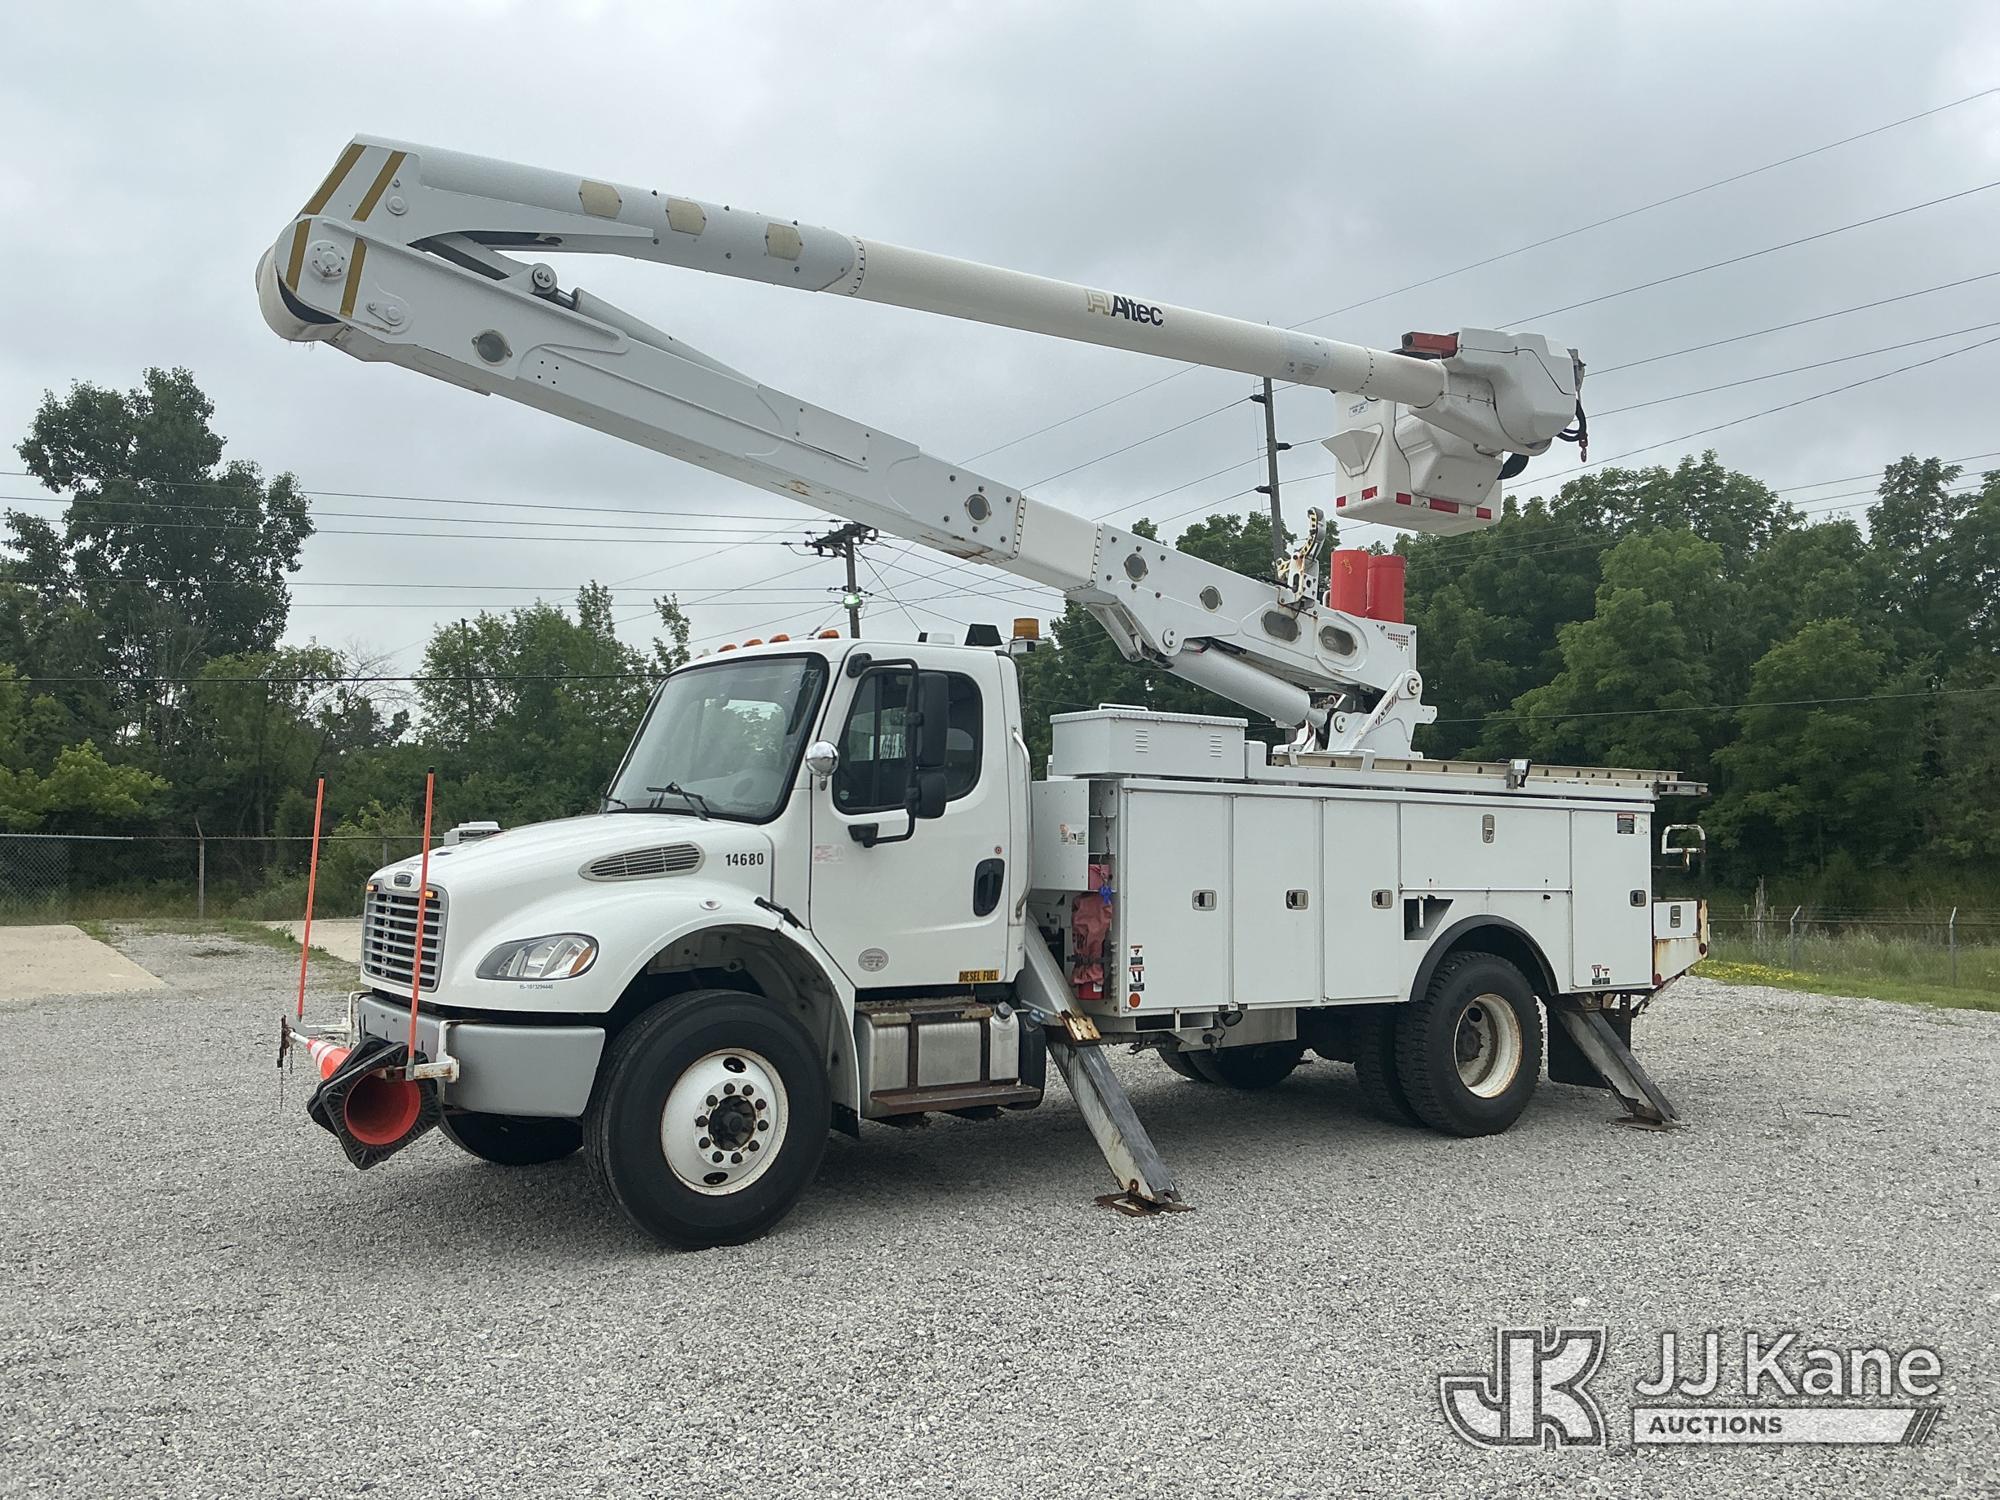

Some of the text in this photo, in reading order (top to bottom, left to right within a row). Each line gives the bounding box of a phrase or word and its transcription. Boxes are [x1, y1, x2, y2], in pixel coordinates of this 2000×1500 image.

[1110, 295, 1164, 326] Altec
[725, 852, 764, 867] 14680
[959, 969, 999, 982] DIESEL FUEL
